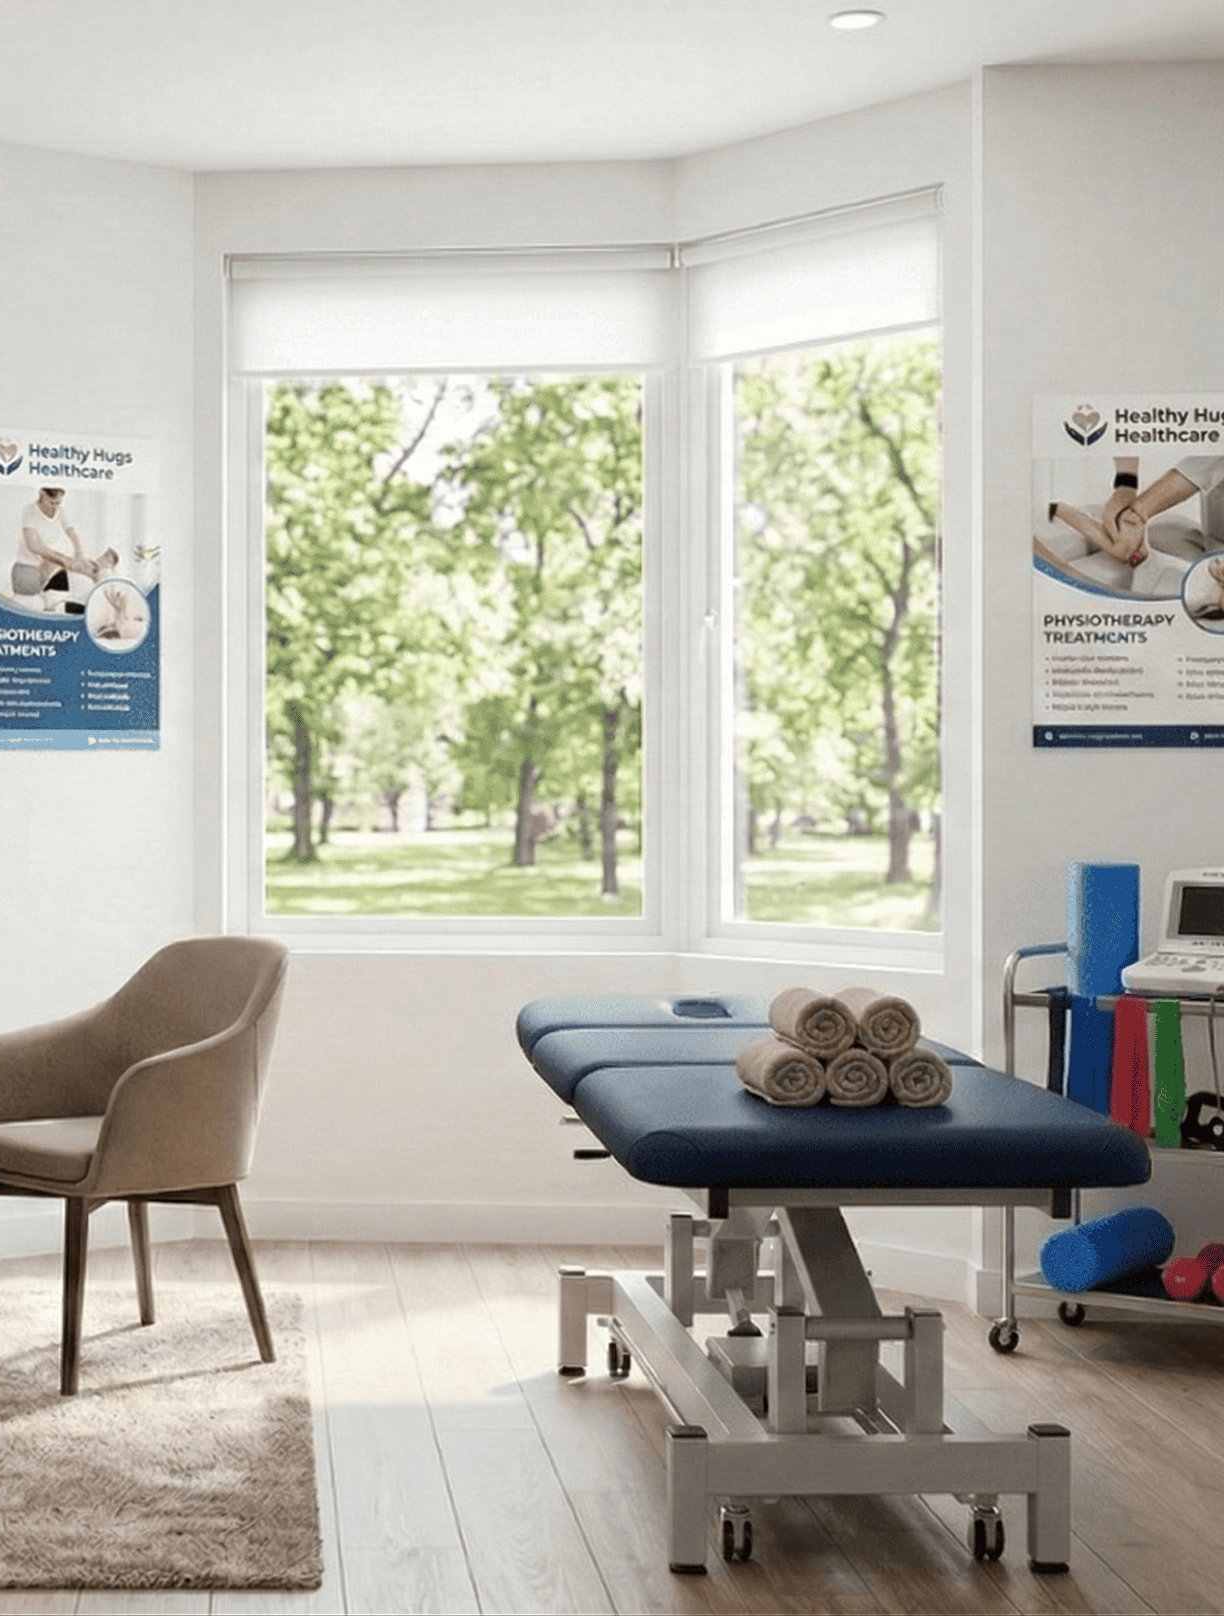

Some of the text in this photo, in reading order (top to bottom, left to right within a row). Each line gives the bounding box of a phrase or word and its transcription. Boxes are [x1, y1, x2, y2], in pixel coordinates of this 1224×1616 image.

[1114, 407, 1189, 427] Healthy
[1114, 427, 1221, 443] Healthcare
[28, 443, 133, 467] Healthy Hugs
[28, 461, 115, 480] Healthcare
[1043, 613, 1176, 627] PHYSIOTHERAPY
